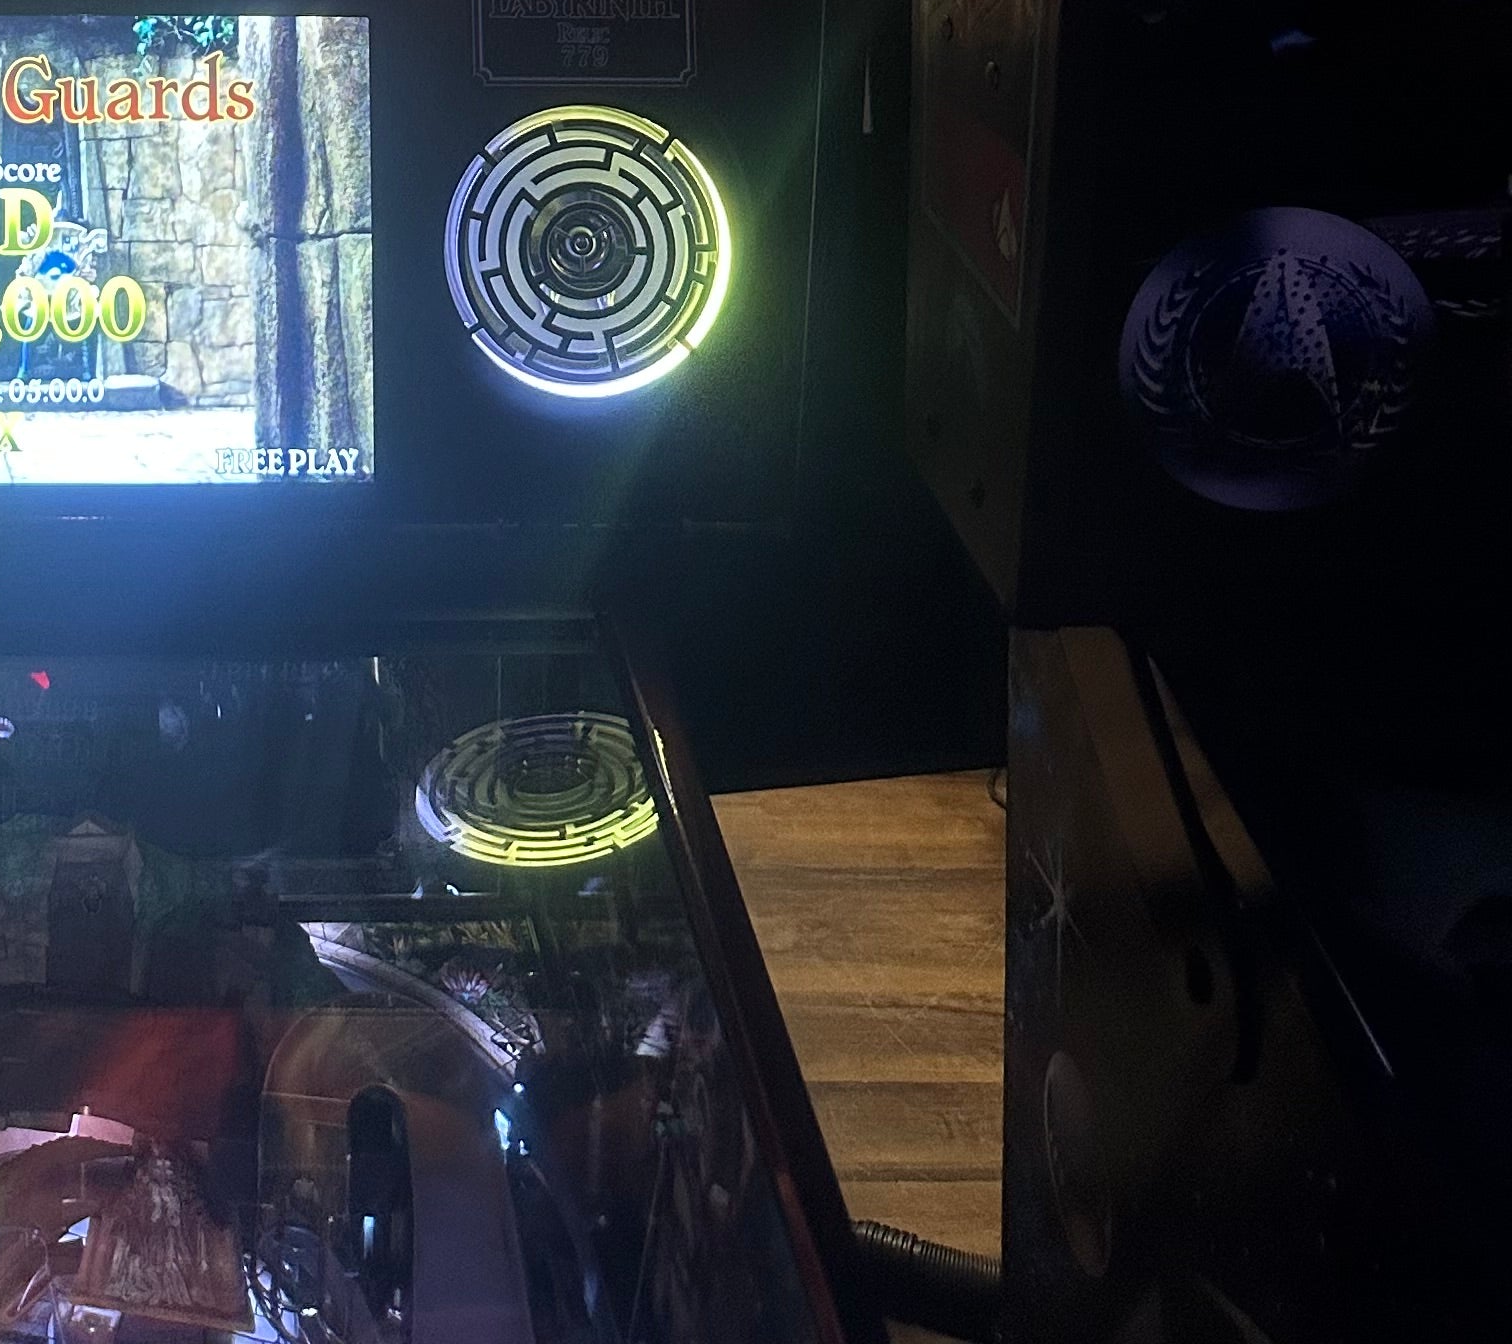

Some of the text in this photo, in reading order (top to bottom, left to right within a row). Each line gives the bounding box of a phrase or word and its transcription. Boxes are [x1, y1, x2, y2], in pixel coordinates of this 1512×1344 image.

[560, 44, 609, 68] 779
[1, 52, 256, 125] Guards
[214, 448, 360, 477] FREE PLAY
